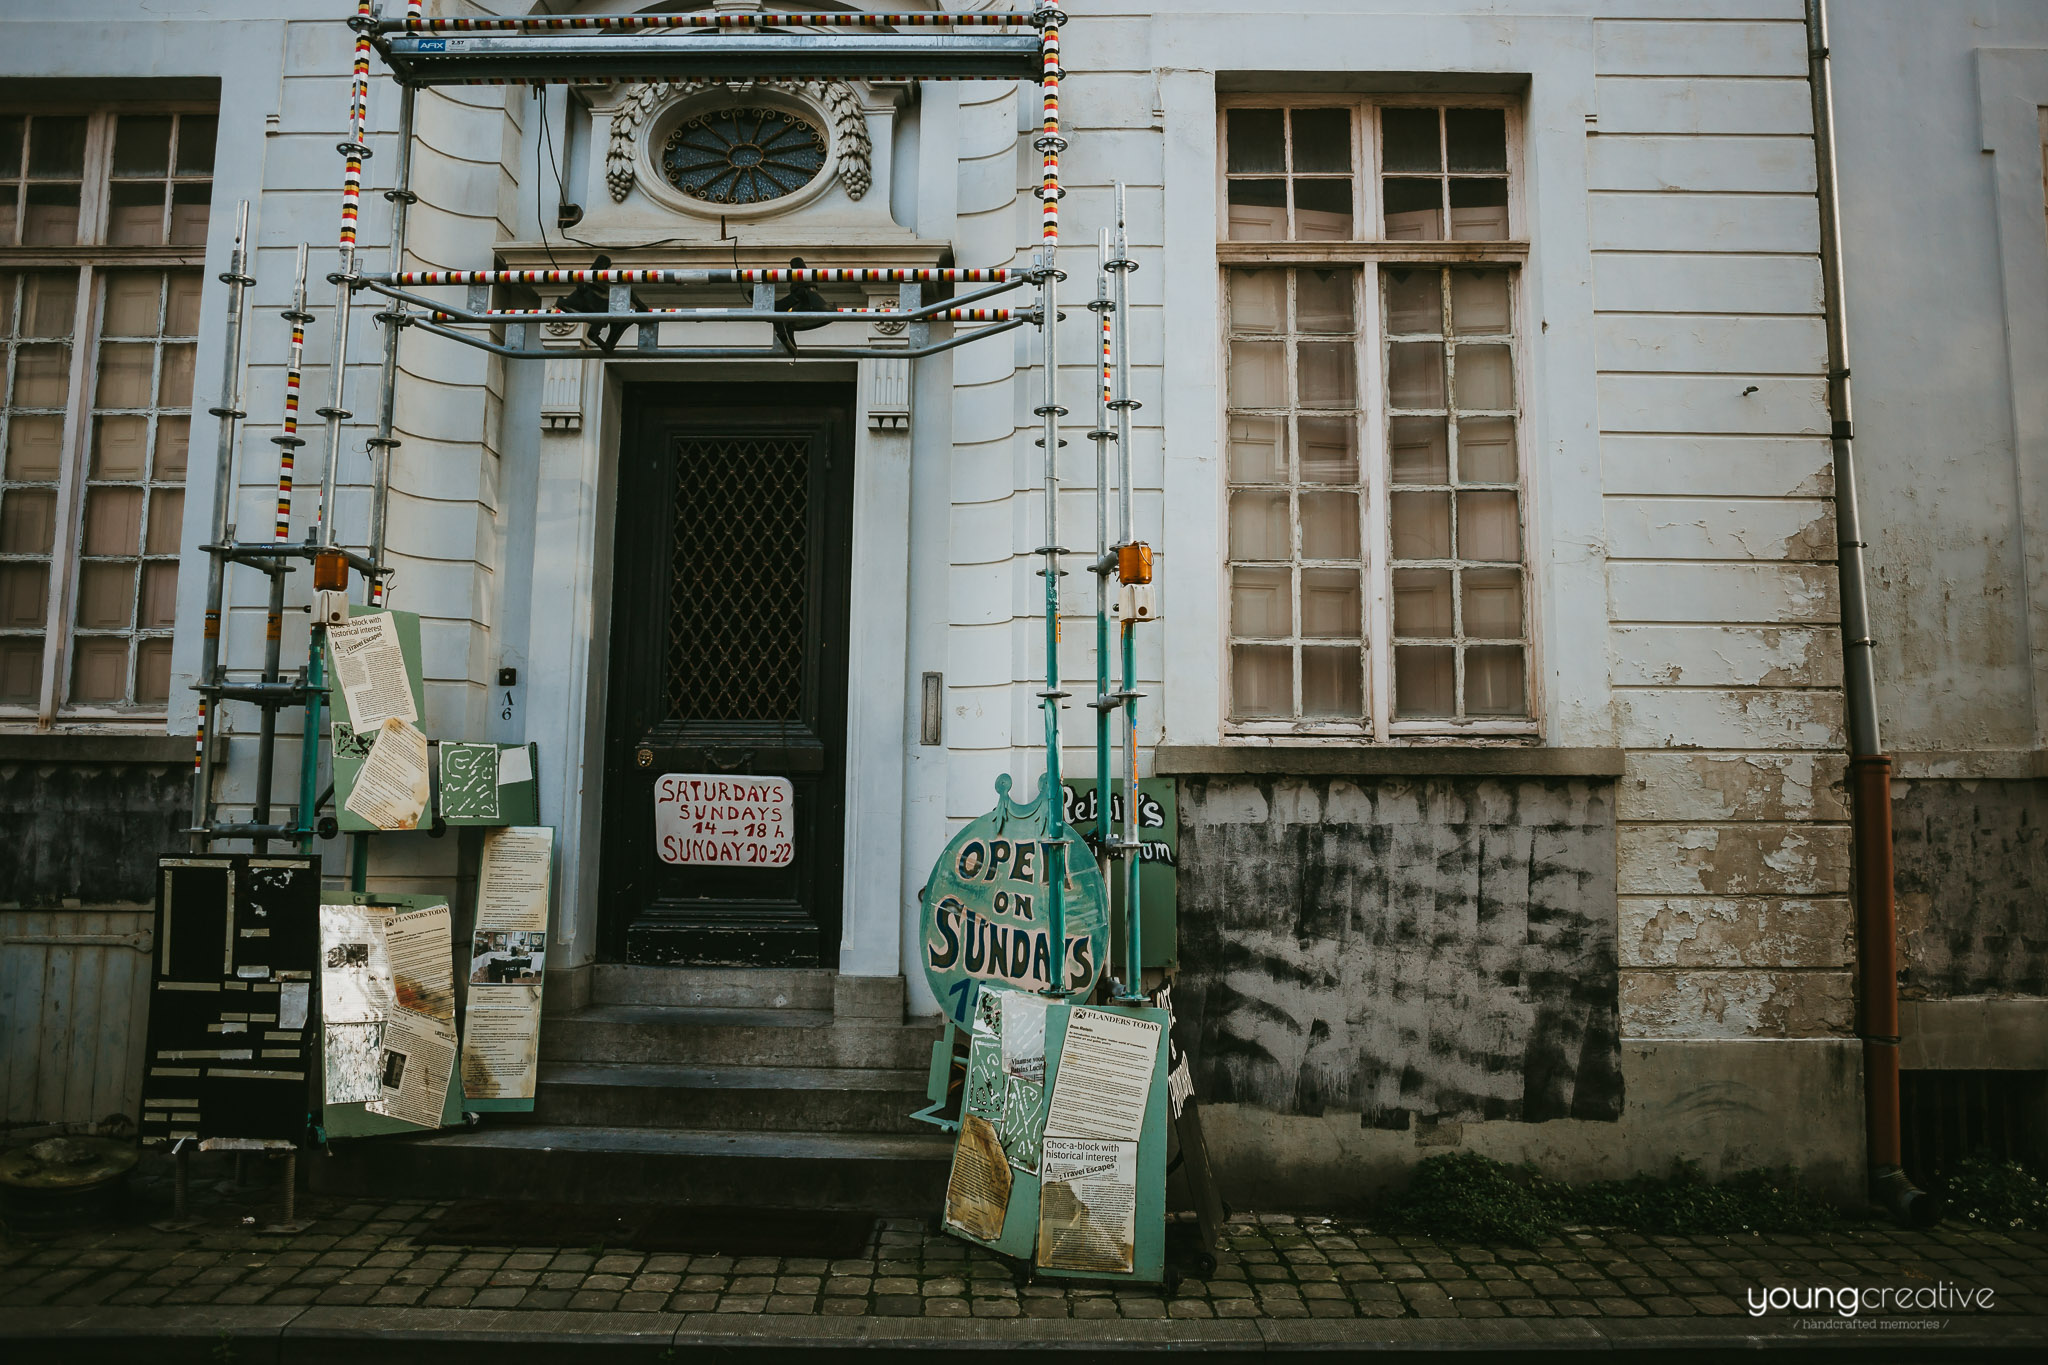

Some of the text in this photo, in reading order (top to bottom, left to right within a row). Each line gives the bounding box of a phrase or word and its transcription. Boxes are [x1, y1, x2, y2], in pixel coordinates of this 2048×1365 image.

[369, 616, 382, 624] with
[331, 625, 383, 638] historical interest
[348, 632, 383, 652] Travel Escapes
[501, 707, 512, 720] 6
[659, 779, 784, 803] SATURDAYS
[679, 804, 782, 822] SUNDAYS
[1063, 785, 1164, 827] Reti's
[692, 822, 717, 835] 14
[744, 823, 767, 838] 18
[663, 835, 745, 862] SUNDAY
[993, 891, 1033, 921] ON
[394, 907, 448, 923] FLANDERS TODAY
[1087, 1011, 1160, 1032] FLANDERS TODAY
[1046, 1140, 1120, 1152] Choc-a-block with
[1046, 1150, 1117, 1162] historical interest
[1045, 1163, 1053, 1173] A
[1063, 1163, 1115, 1179] Travel Escapes
